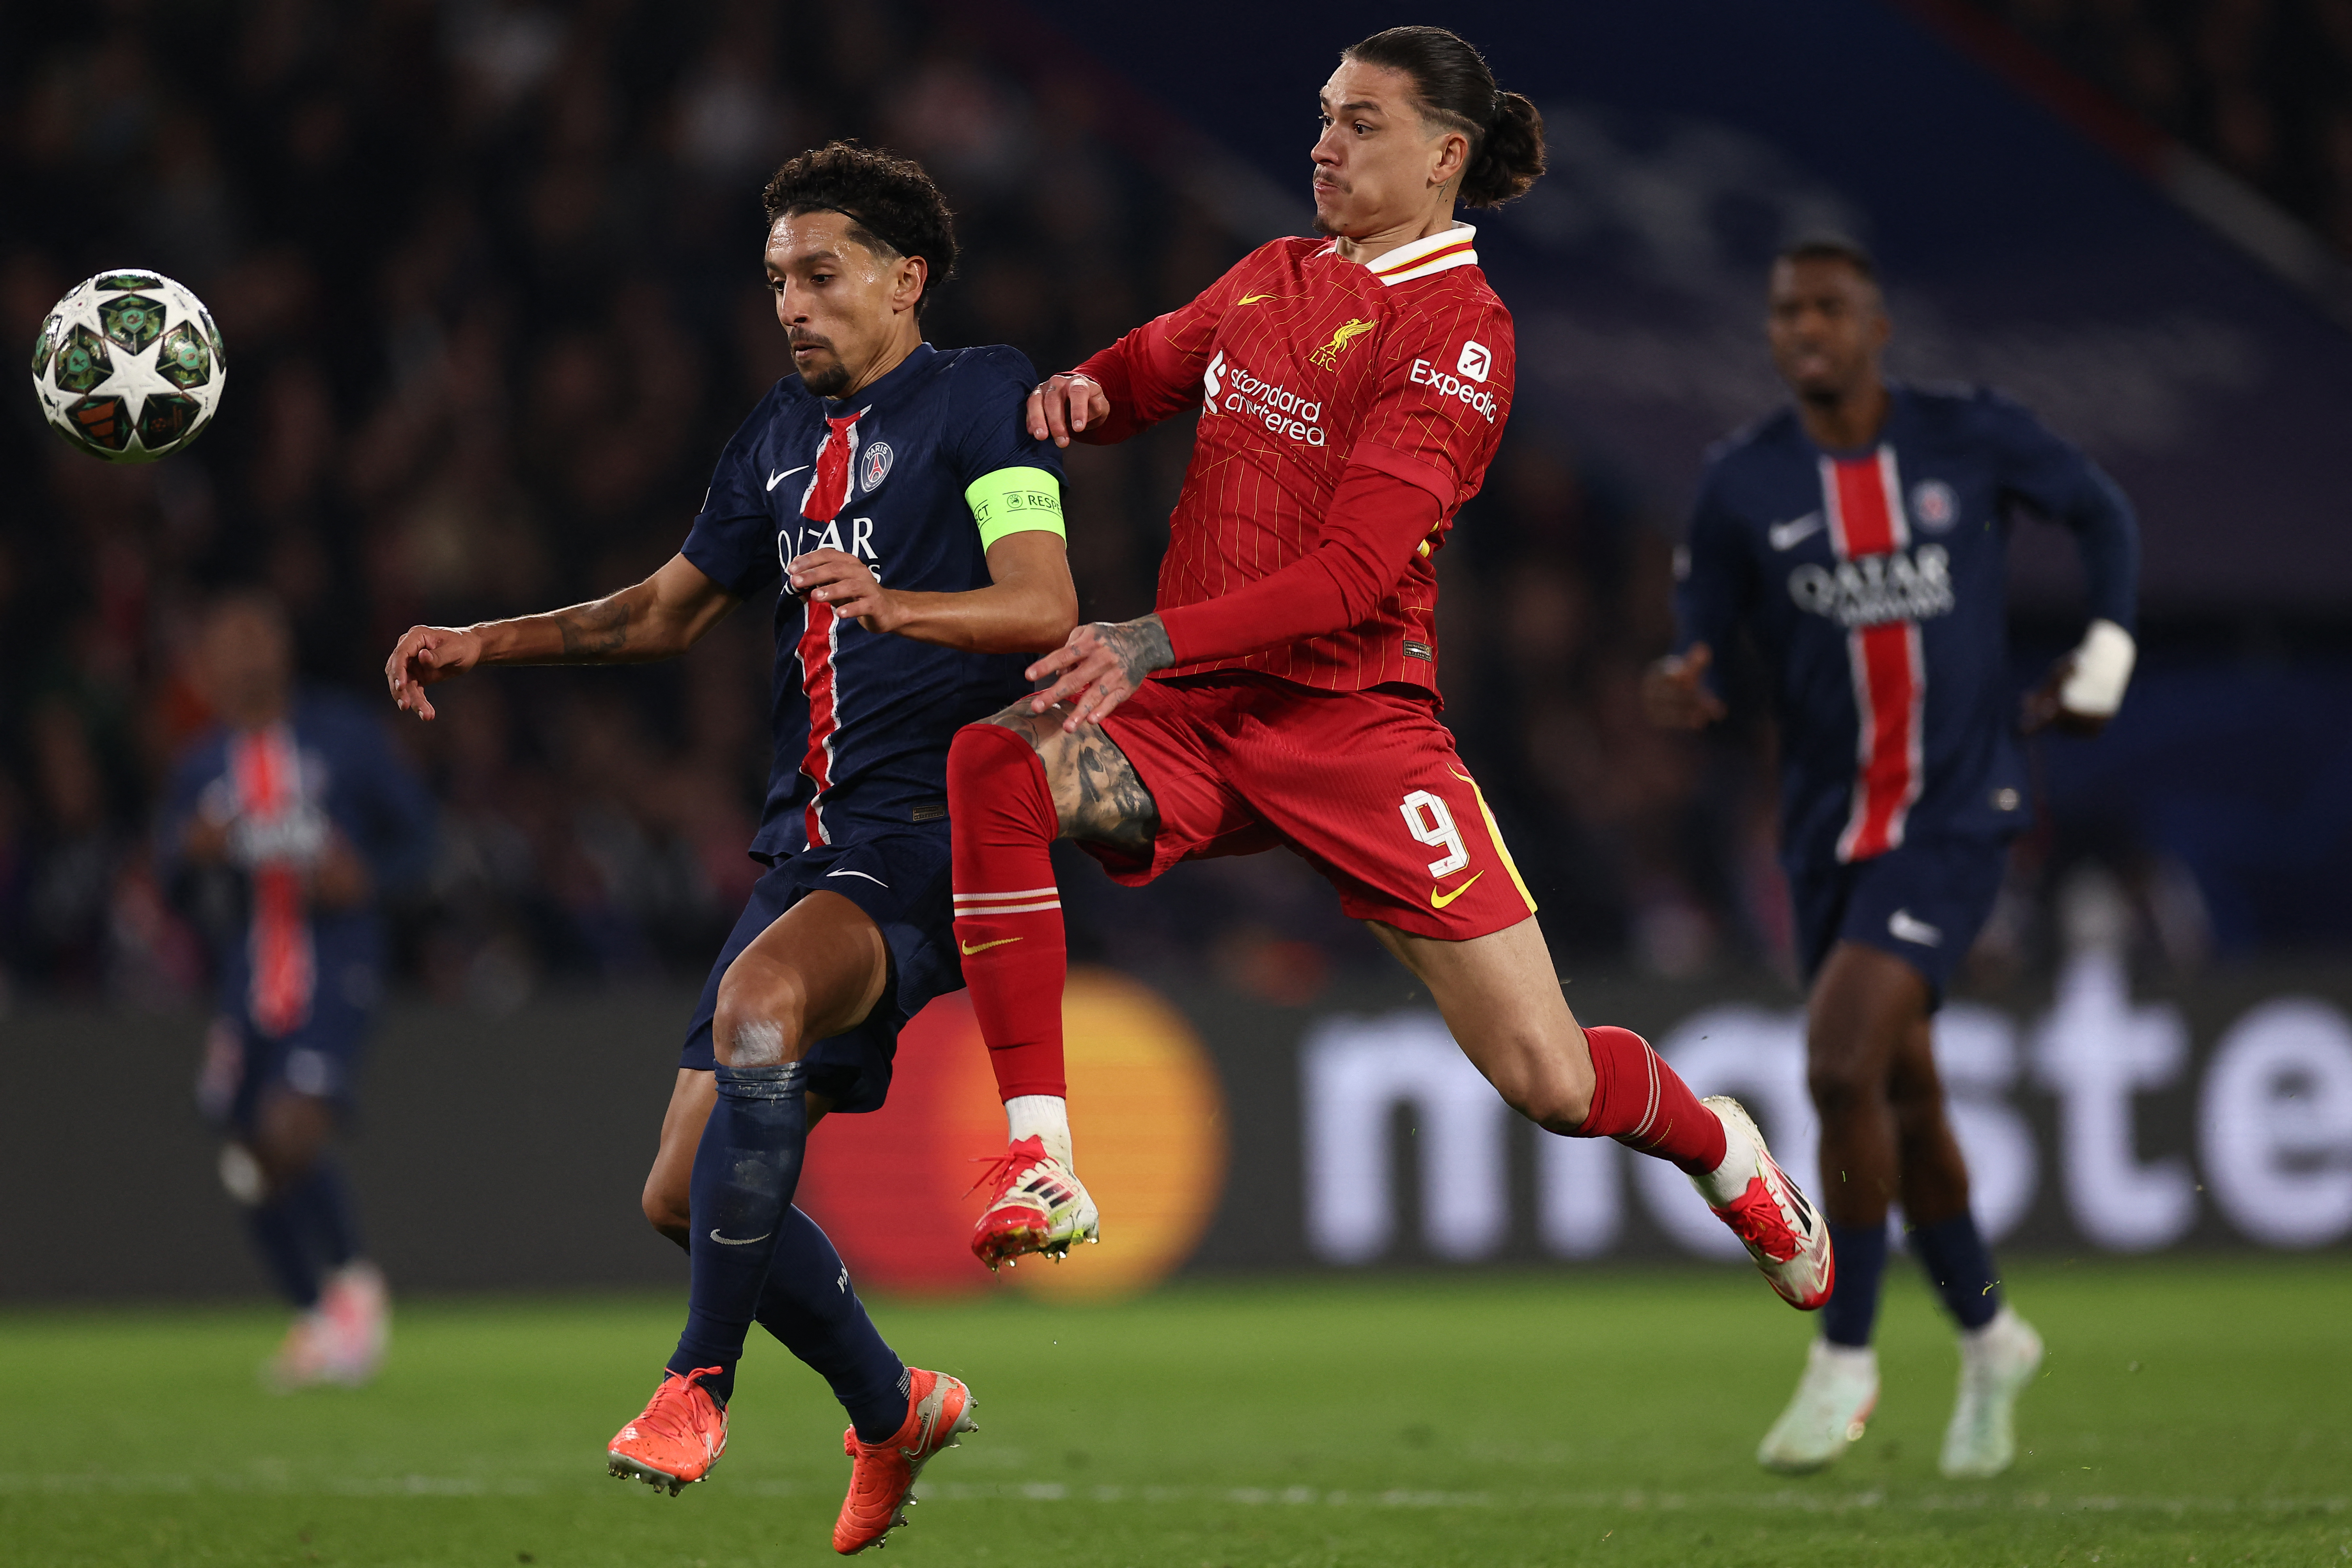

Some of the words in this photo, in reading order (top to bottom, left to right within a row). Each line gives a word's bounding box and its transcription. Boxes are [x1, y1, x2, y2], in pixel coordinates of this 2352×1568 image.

[1231, 368, 1322, 423] standard
[1410, 358, 1497, 424] Expedia
[866, 445, 888, 460] PARIS
[778, 517, 879, 576] QAR
[1399, 789, 1471, 879] 9
